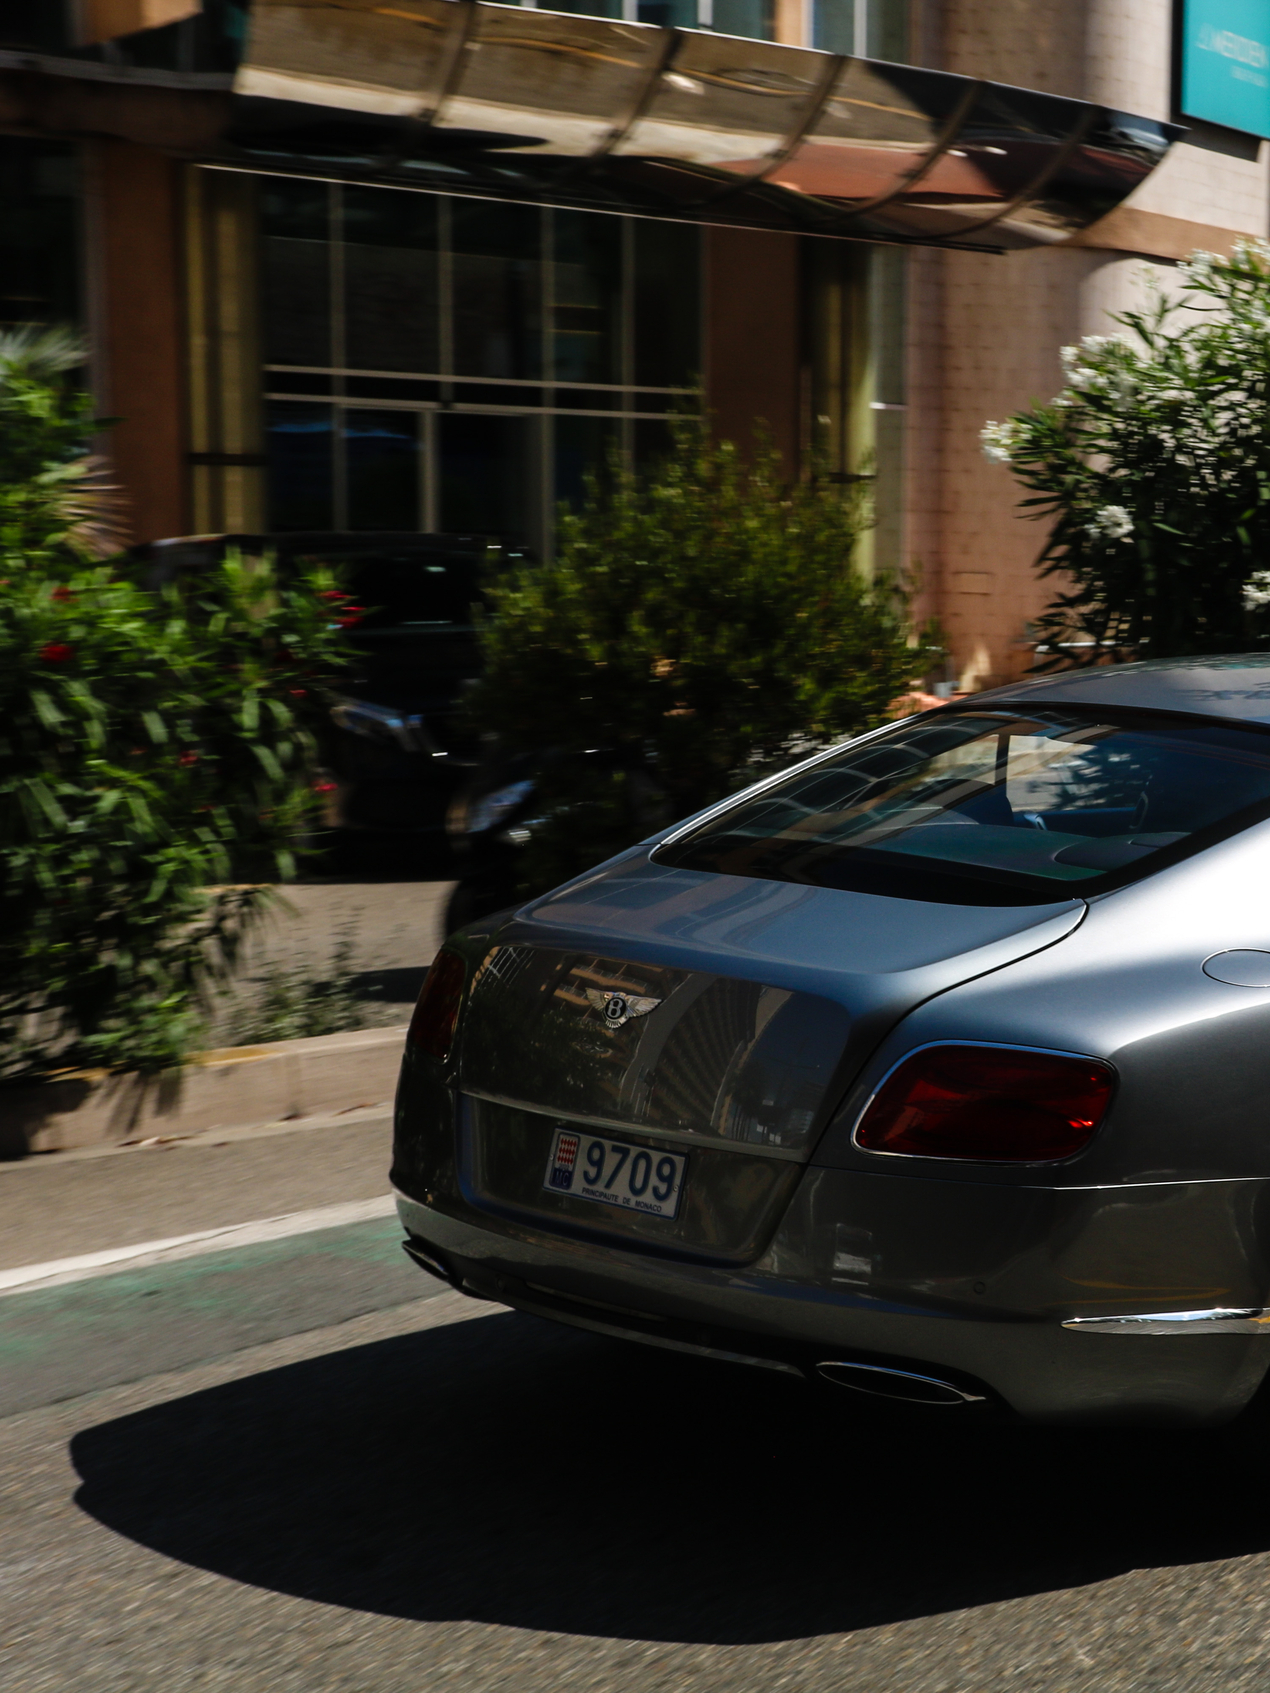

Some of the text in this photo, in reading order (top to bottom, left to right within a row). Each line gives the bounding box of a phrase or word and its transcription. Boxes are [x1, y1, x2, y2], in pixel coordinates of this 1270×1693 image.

[555, 1170, 570, 1186] MC
[583, 1140, 677, 1202] 9709
[581, 1187, 662, 1213] PRINCIPAUTE DE MONACO
